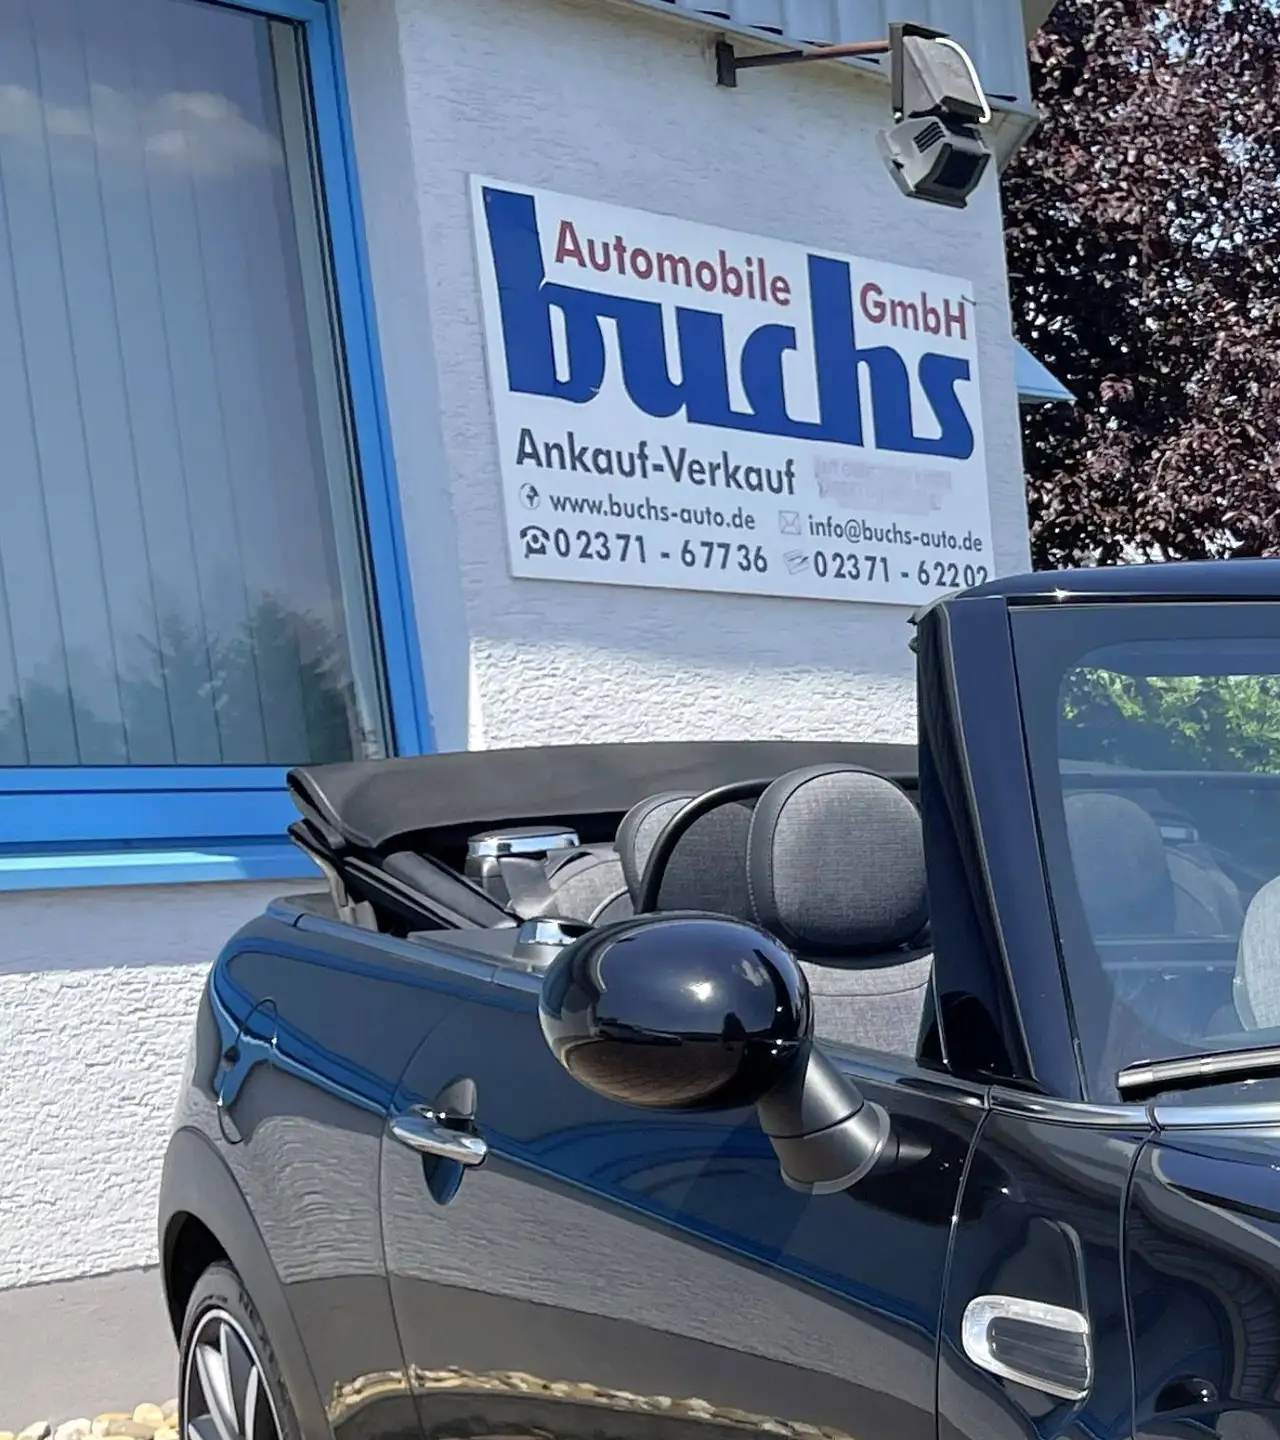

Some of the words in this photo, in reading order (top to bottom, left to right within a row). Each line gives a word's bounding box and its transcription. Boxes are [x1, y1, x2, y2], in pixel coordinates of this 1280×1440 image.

[555, 219, 791, 306] Automobile
[860, 282, 967, 340] GmbH
[482, 186, 975, 460] buchs
[516, 428, 794, 495] Ankauf-Verkauf
[549, 494, 756, 530] www.buchs-auto.de
[808, 514, 982, 552] info@buchs-auto.de
